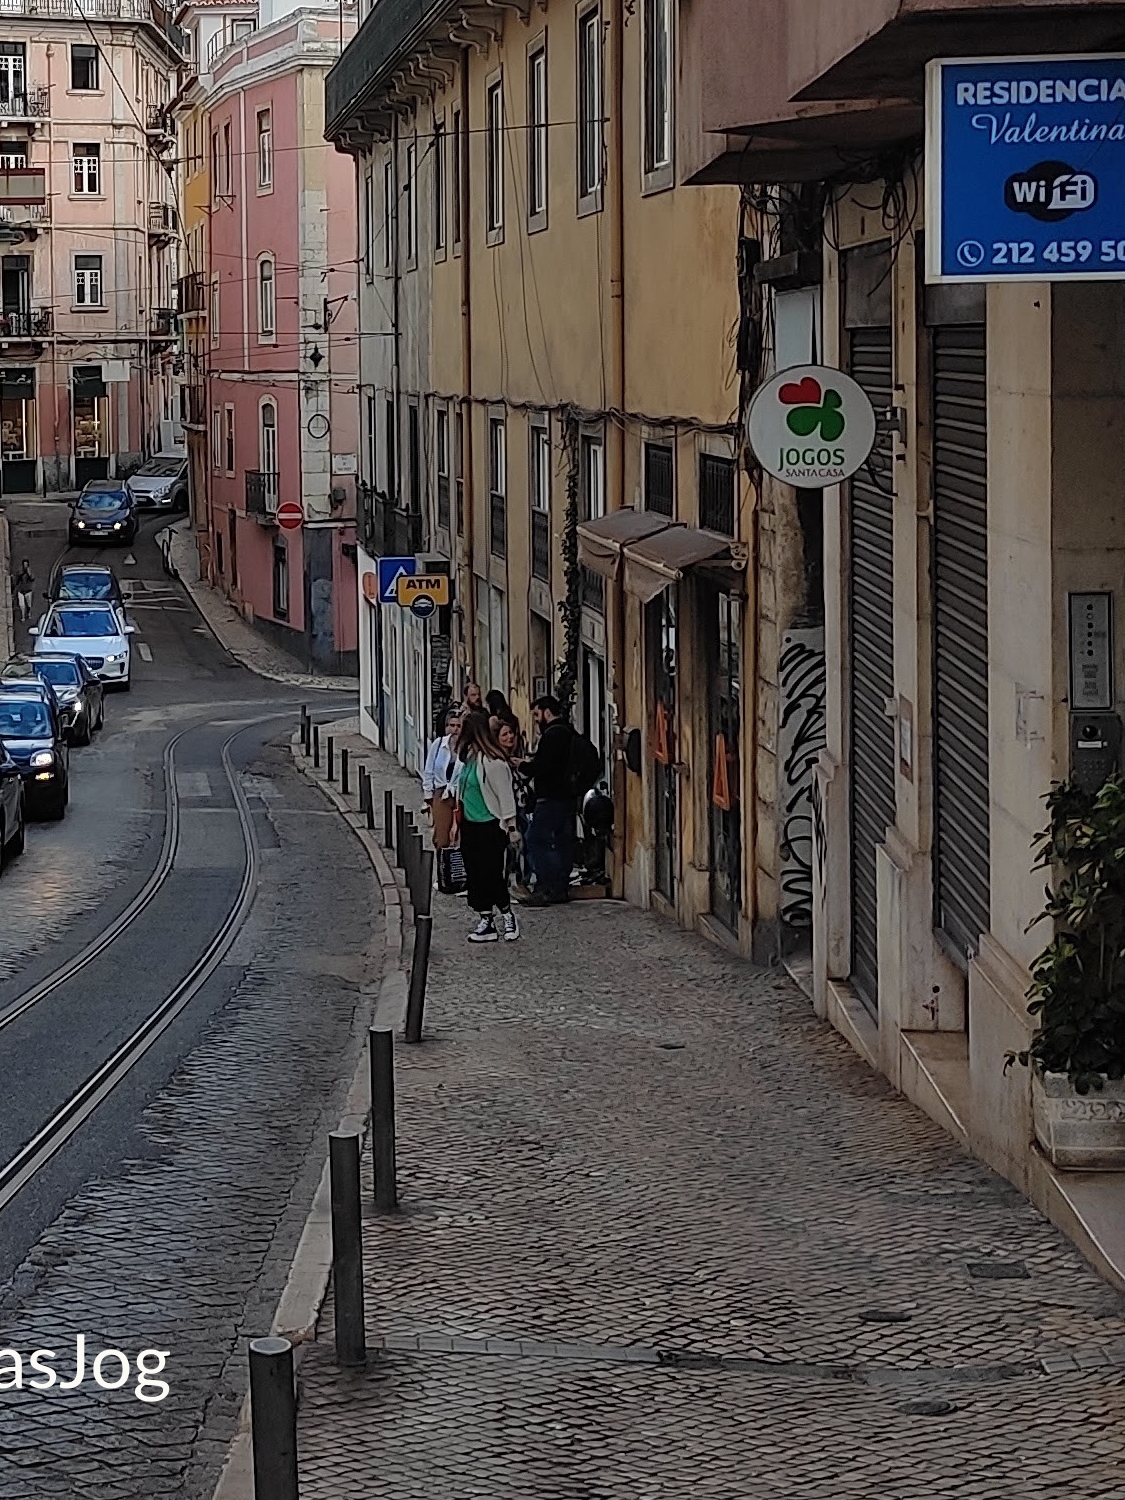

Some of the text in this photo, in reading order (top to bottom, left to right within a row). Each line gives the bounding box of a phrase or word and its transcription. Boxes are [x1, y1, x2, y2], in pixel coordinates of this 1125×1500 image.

[956, 78, 1125, 106] RESIDENCIA
[971, 111, 1125, 145] Valentina
[991, 241, 1035, 265] 212
[1042, 240, 1093, 263] 459
[777, 447, 845, 472] JOGOS
[405, 578, 441, 590] ATM
